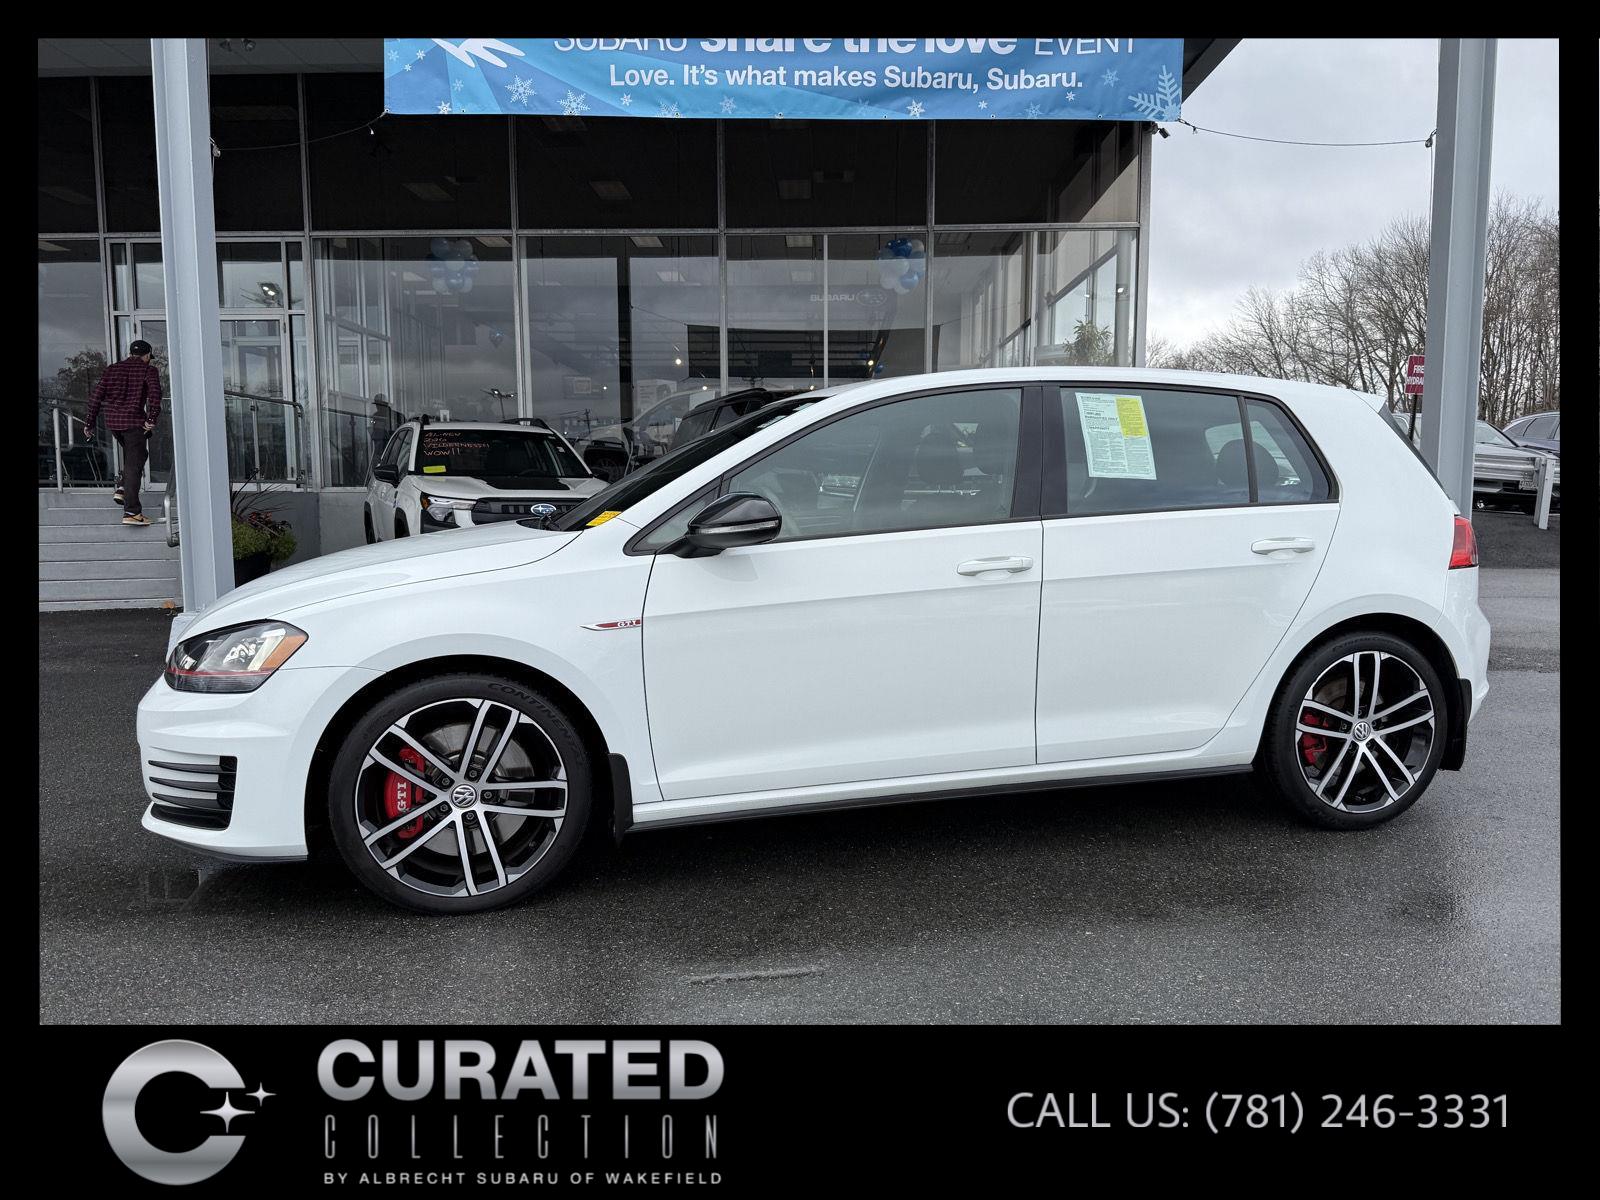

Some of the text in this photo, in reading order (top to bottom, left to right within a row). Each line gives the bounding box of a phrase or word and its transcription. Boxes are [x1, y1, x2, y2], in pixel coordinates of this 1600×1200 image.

[609, 64, 1083, 93] Love. It's what makes Subaru, Subaru.
[1405, 376, 1425, 386] HYDRA
[397, 781, 407, 812] GTI
